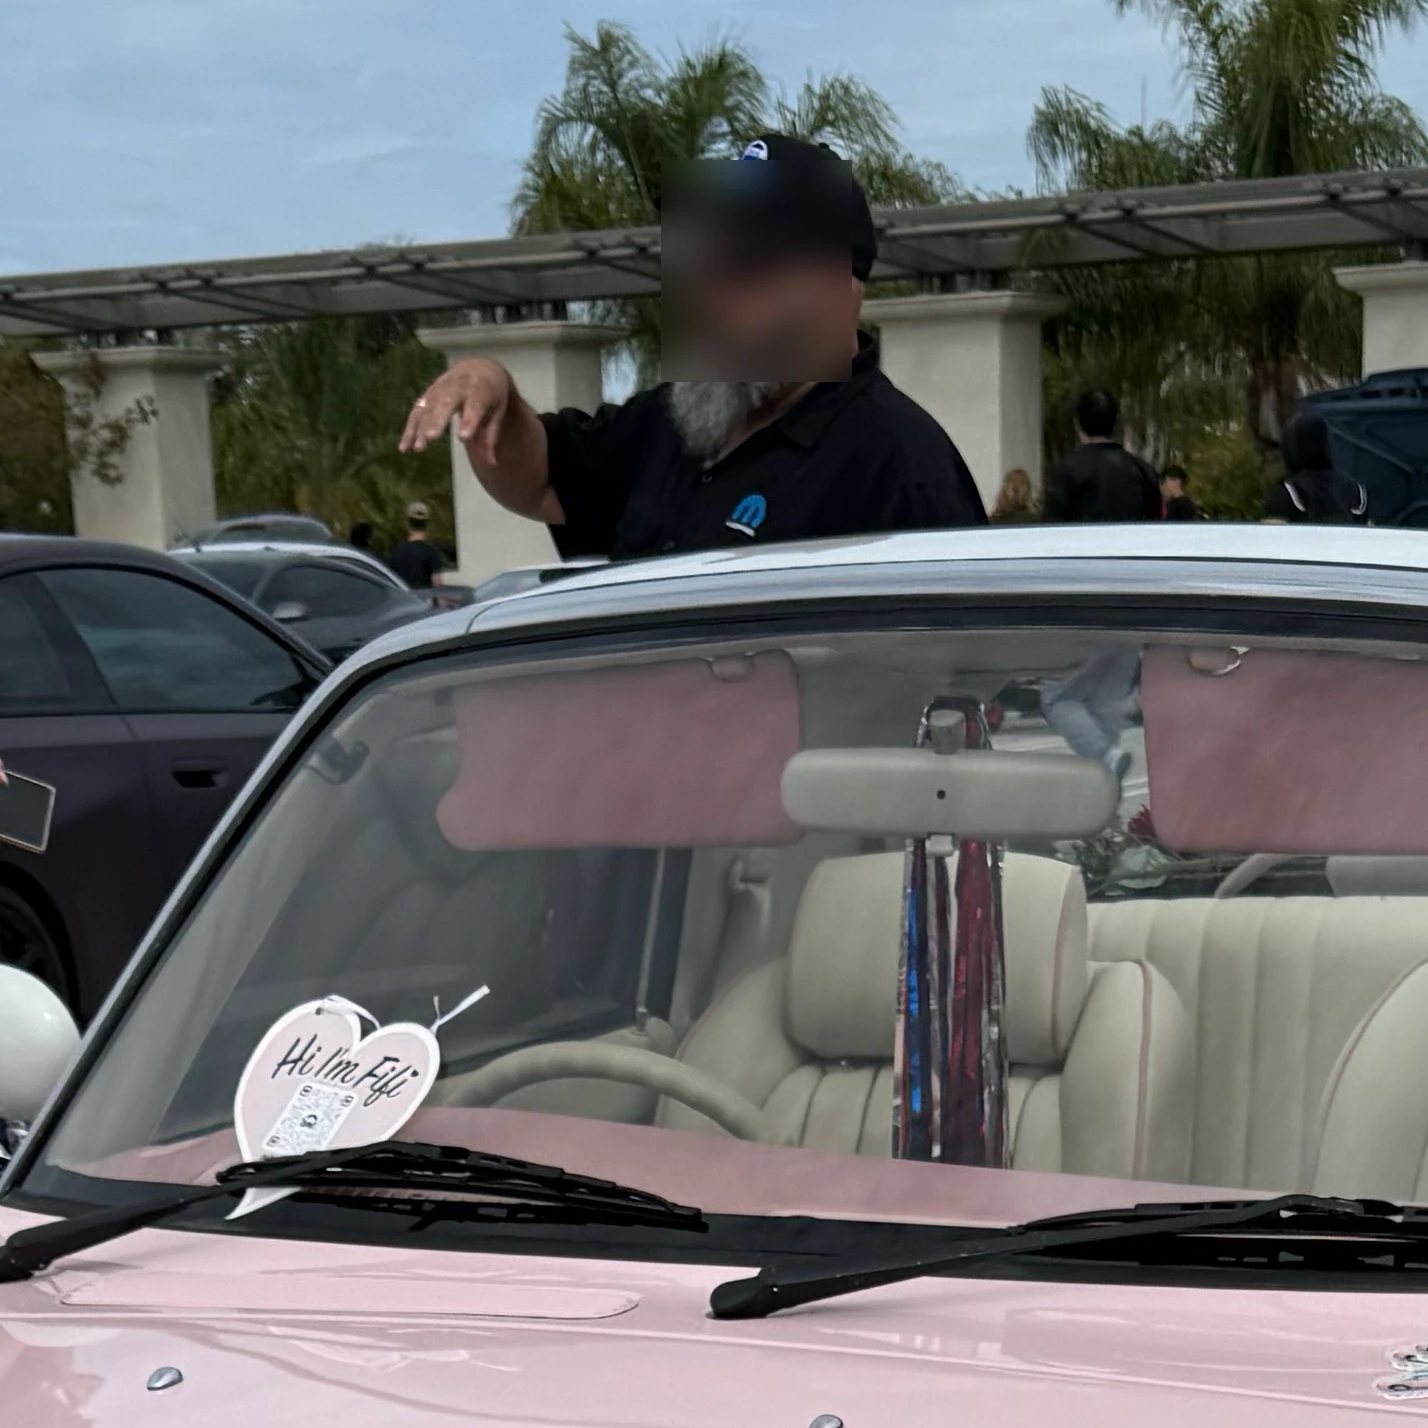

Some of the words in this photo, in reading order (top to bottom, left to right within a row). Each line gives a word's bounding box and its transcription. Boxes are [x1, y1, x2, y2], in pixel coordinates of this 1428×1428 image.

[271, 1033, 322, 1079] Hi
[314, 1047, 360, 1084] I'm
[352, 1056, 420, 1108] Fifi
